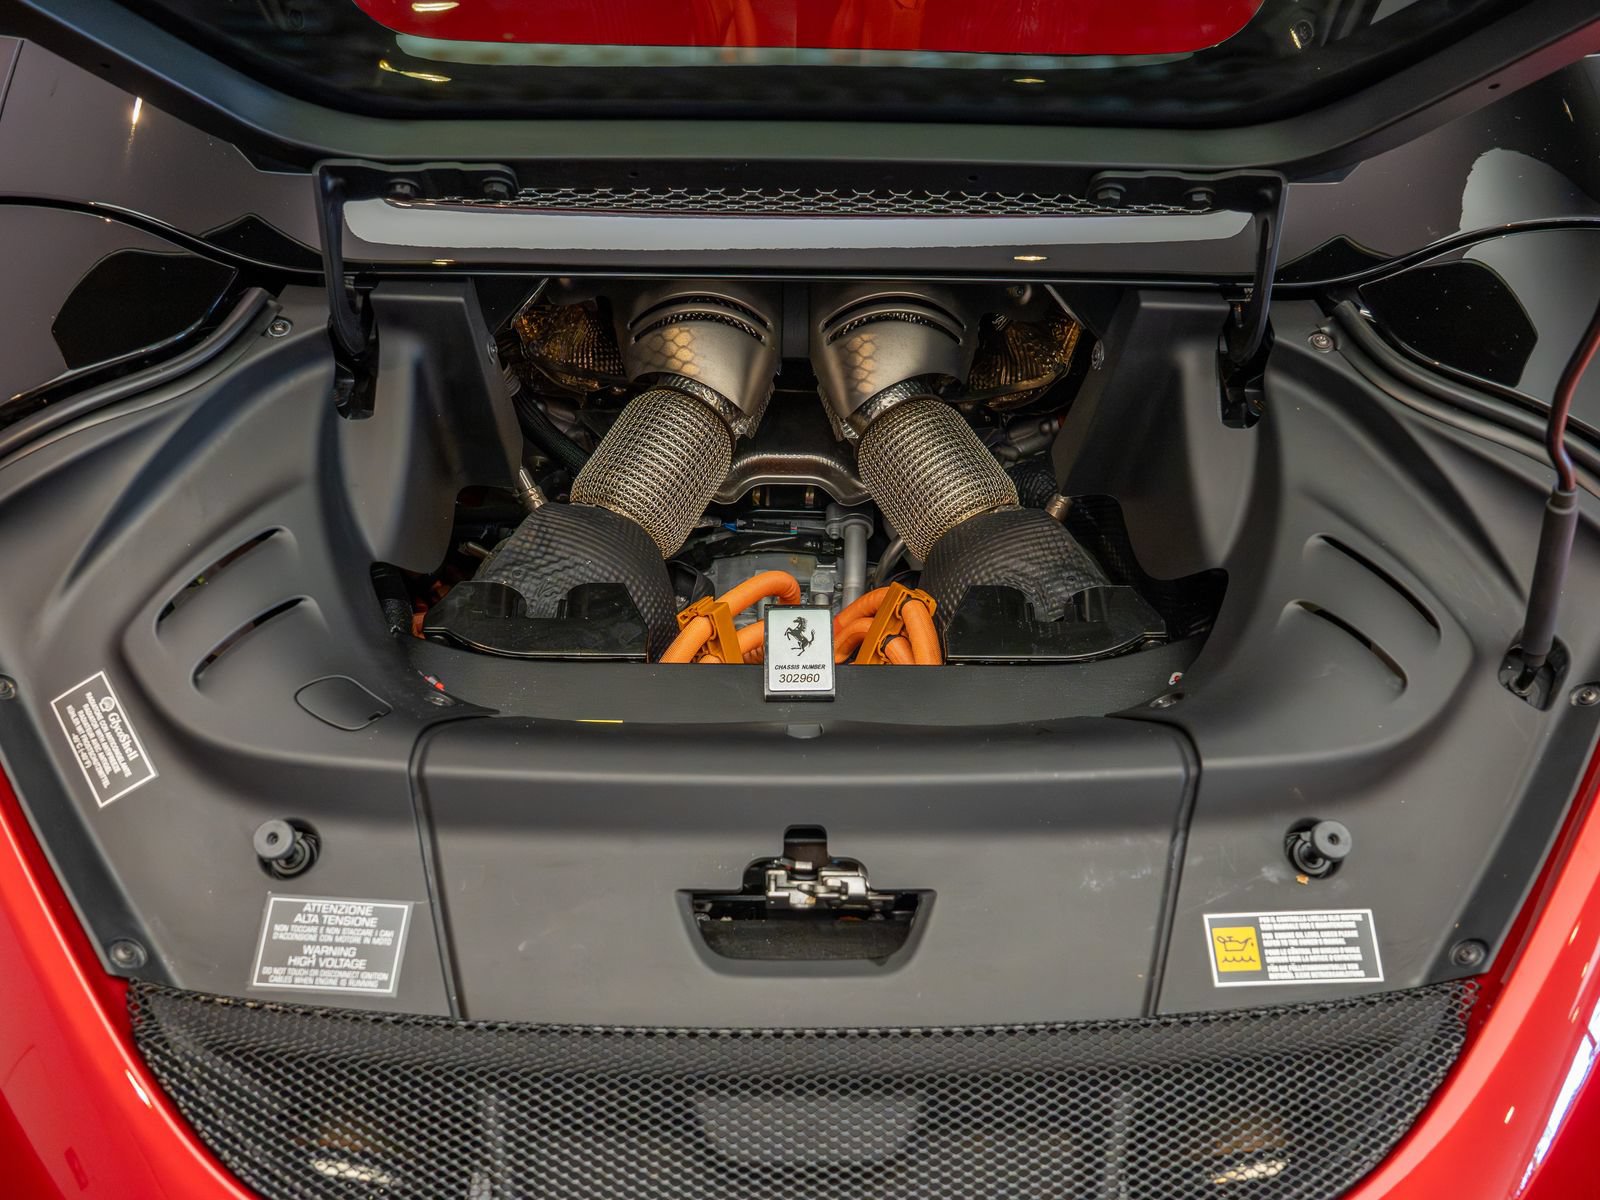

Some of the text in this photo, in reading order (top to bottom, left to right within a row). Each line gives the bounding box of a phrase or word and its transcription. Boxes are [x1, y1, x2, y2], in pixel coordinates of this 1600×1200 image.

[779, 673, 820, 683] 302960
[108, 712, 139, 761] GlycoShell
[303, 903, 373, 915] ATTENZIONE
[294, 914, 378, 927] ALTA TENSIONE
[274, 924, 289, 932] NON
[290, 925, 319, 933] TOCCARE
[325, 926, 340, 935] NON
[379, 930, 394, 938] CAVI
[334, 935, 362, 944] MOTORE
[372, 937, 392, 946] MOTO
[303, 944, 357, 957] WARNING
[288, 956, 367, 970] HIGH VOLTAGE
[262, 967, 272, 975] DO
[273, 967, 286, 975] NOT
